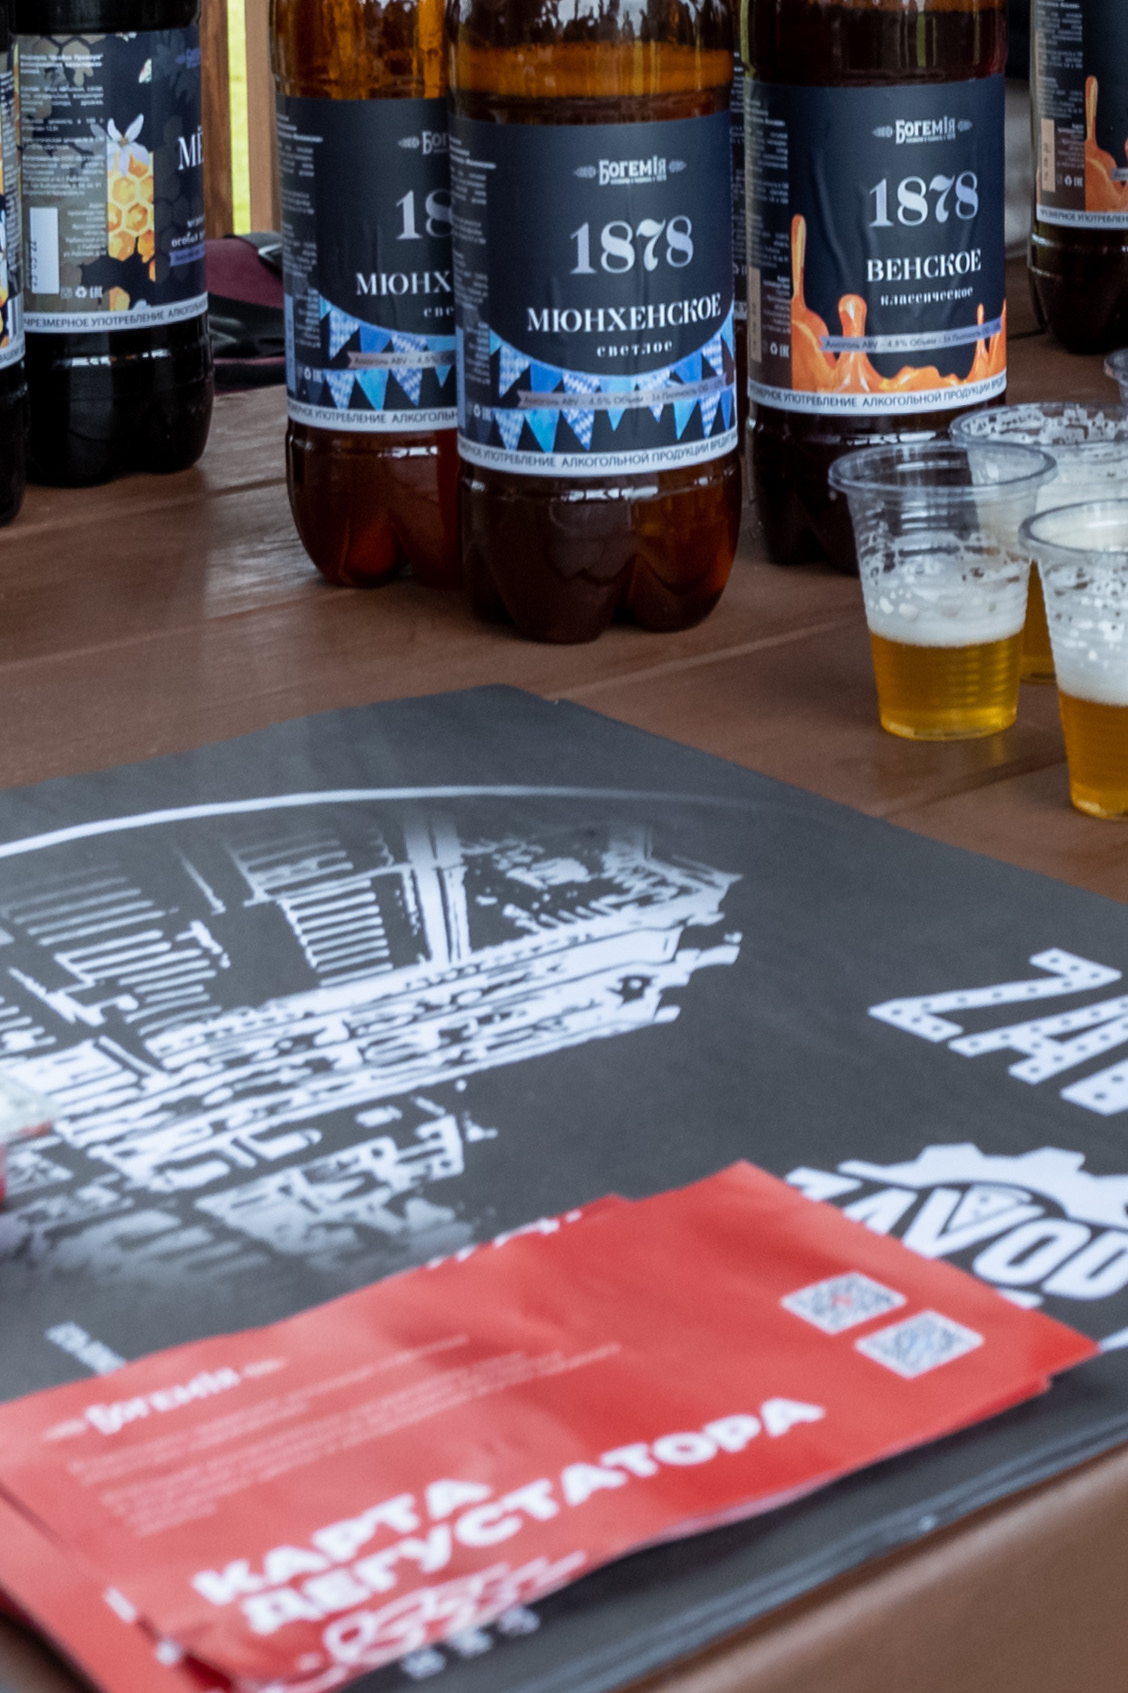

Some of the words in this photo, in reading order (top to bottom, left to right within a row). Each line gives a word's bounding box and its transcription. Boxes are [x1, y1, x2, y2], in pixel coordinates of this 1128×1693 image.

[868, 170, 979, 227] 1878
[569, 214, 694, 275] 1878
[866, 248, 982, 282] ВЕНСКОЕ
[880, 286, 974, 306] классическое
[24, 313, 89, 328] ЧРЕЗМЕРНОЕ
[91, 310, 164, 327] УПОТРЕБЛЕНИЕ
[527, 292, 721, 333] МЮНХЕНСКОЕ
[596, 340, 673, 358] светлое
[784, 390, 857, 408] УПОТРЕБЛЕНИЕ
[862, 393, 942, 408] АЛКОГОЛЬНОЙ
[943, 383, 990, 403] ПРОДУКЦИИ
[315, 407, 386, 424] УПОТРЕБЛЕНИЕ
[483, 447, 556, 467] УПОТРЕБЛЕНИЕ
[561, 451, 650, 468] АЛКОГОЛЬНОЙ
[651, 444, 710, 465] ПРОДУКЦИИ
[237, 1397, 826, 1636] ДЕГУСТАТОРА
[191, 1478, 493, 1606] КАРТА
